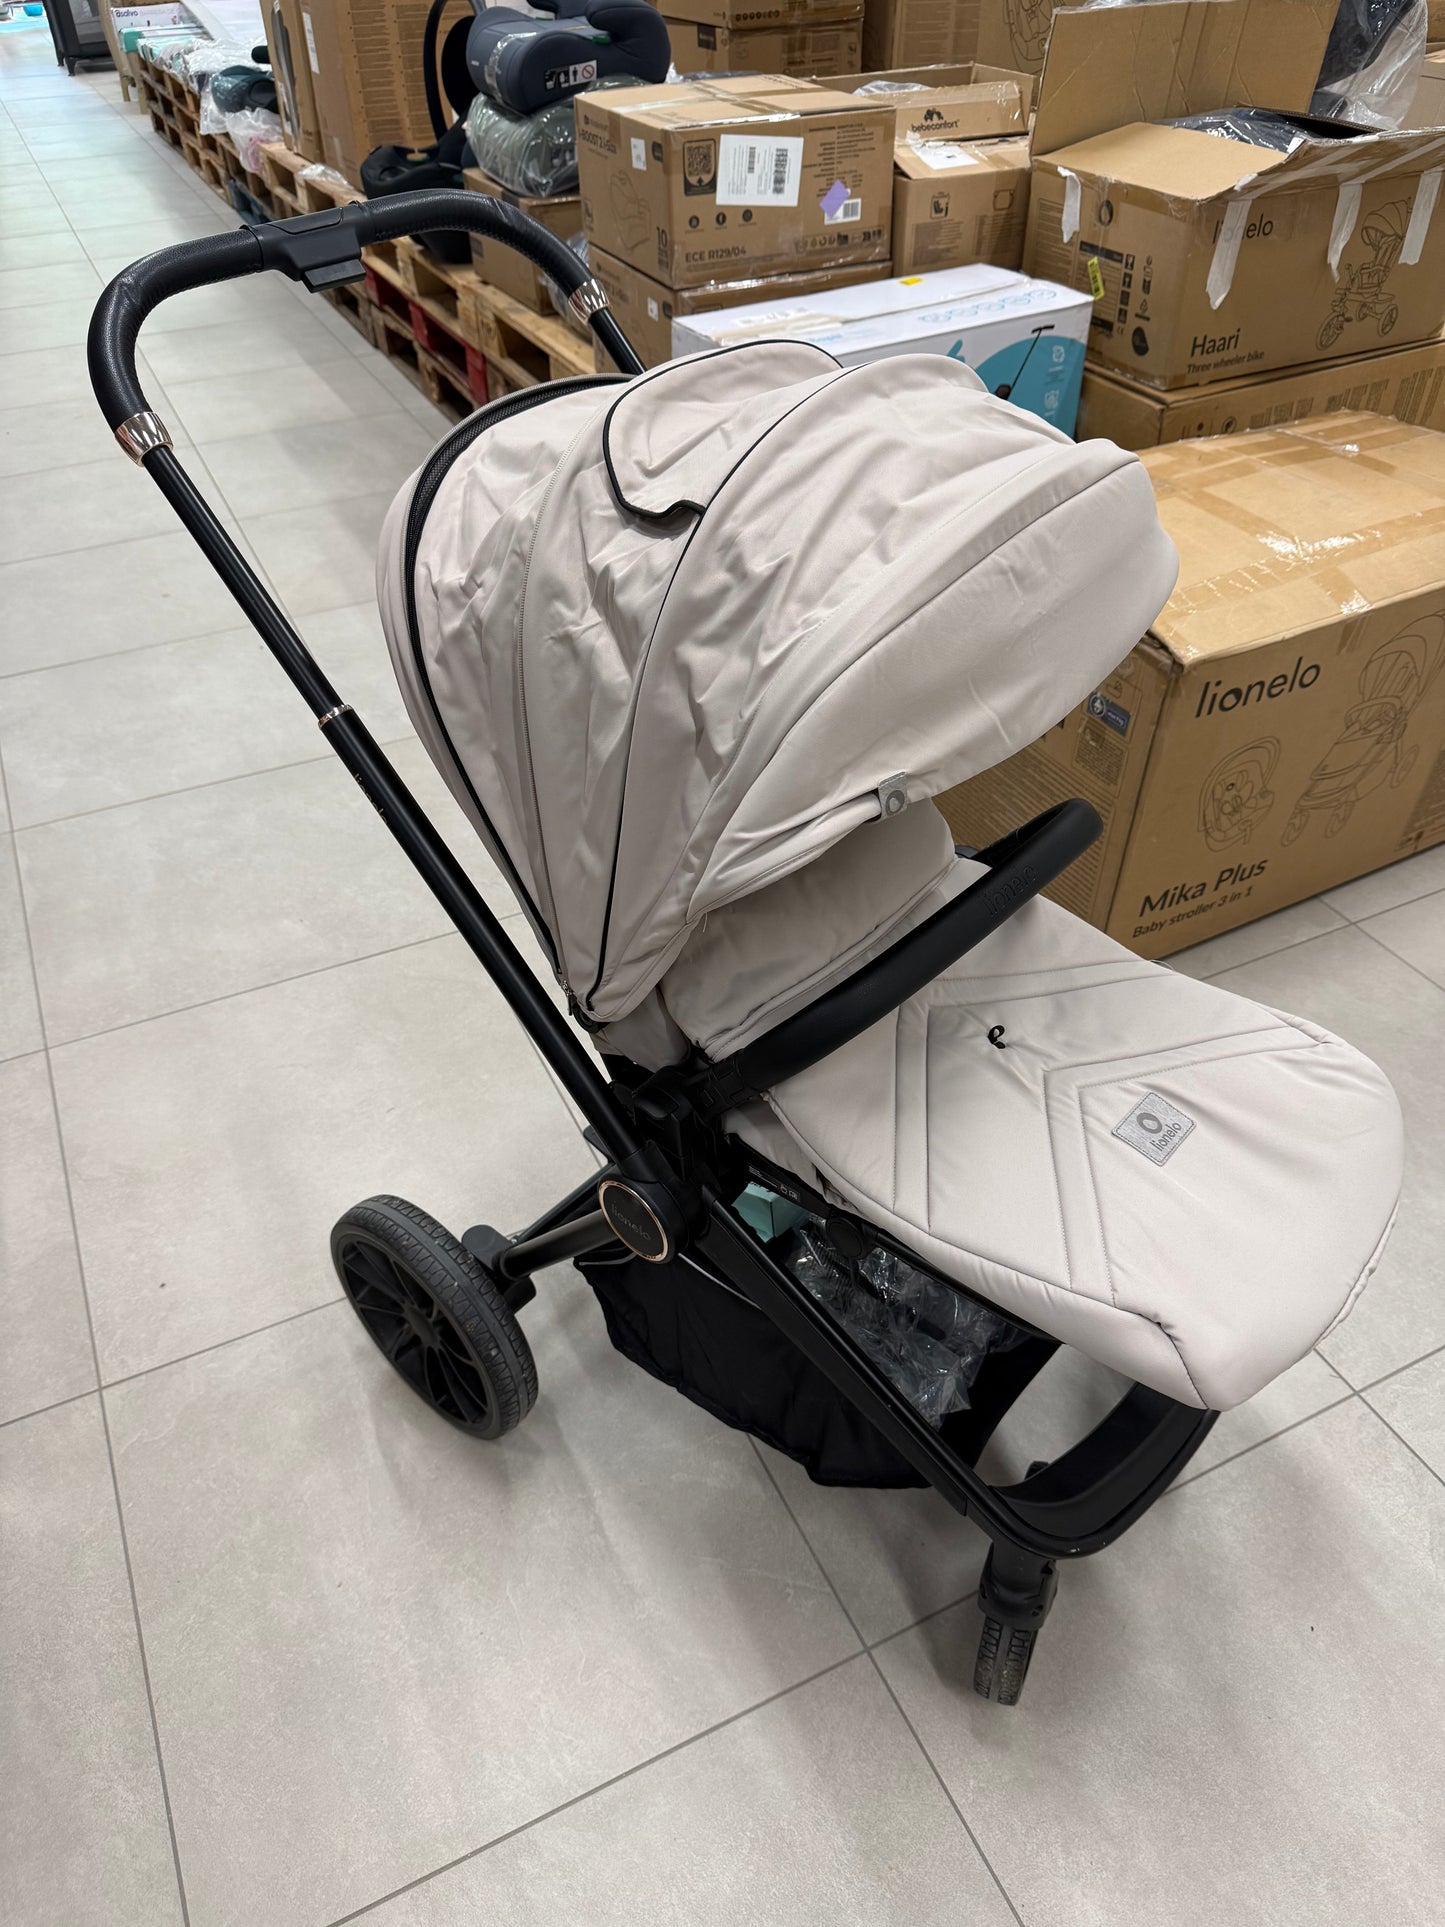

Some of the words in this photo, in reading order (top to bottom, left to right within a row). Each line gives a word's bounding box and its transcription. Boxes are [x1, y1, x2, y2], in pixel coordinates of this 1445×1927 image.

[911, 121, 959, 132] bebeconfort
[685, 252, 705, 264] ECE
[708, 246, 747, 260] R129/04
[1190, 327, 1241, 358] Haari
[1187, 362, 1212, 374] Three
[1213, 354, 1246, 369] wheeler
[1246, 349, 1265, 362] bike
[1195, 656, 1321, 718] lionelo
[1139, 882, 1207, 917] Mika
[1213, 859, 1268, 892] Plus
[1132, 920, 1167, 938] Baby
[1168, 901, 1217, 926] stroller
[1217, 895, 1228, 908] 3
[1228, 890, 1242, 903] in
[1245, 885, 1253, 897] 1
[1149, 1122, 1182, 1152] lionelo
[610, 1200, 651, 1240] lionelo
